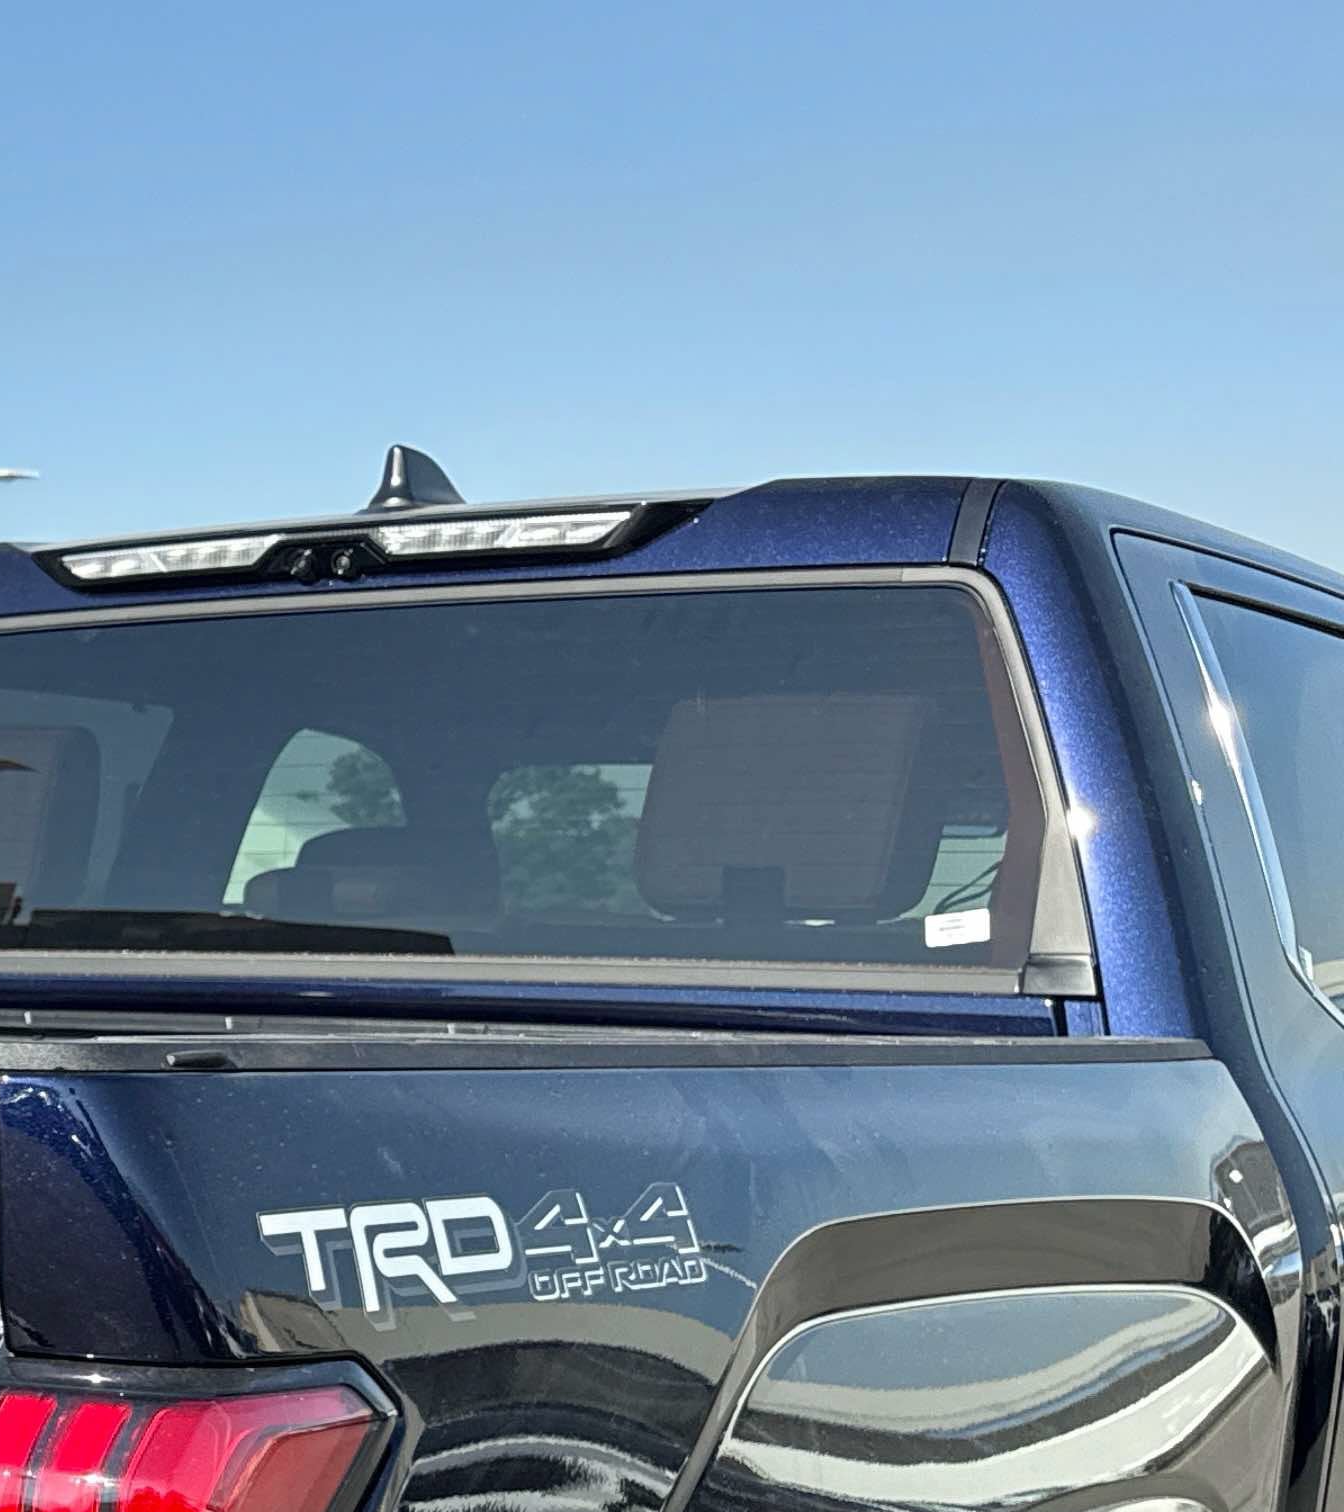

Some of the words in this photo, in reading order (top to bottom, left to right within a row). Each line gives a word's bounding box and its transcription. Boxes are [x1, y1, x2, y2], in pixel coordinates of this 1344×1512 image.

[257, 1195, 514, 1314] TRD
[528, 1266, 606, 1301] OFF
[607, 1257, 708, 1293] ROAD
